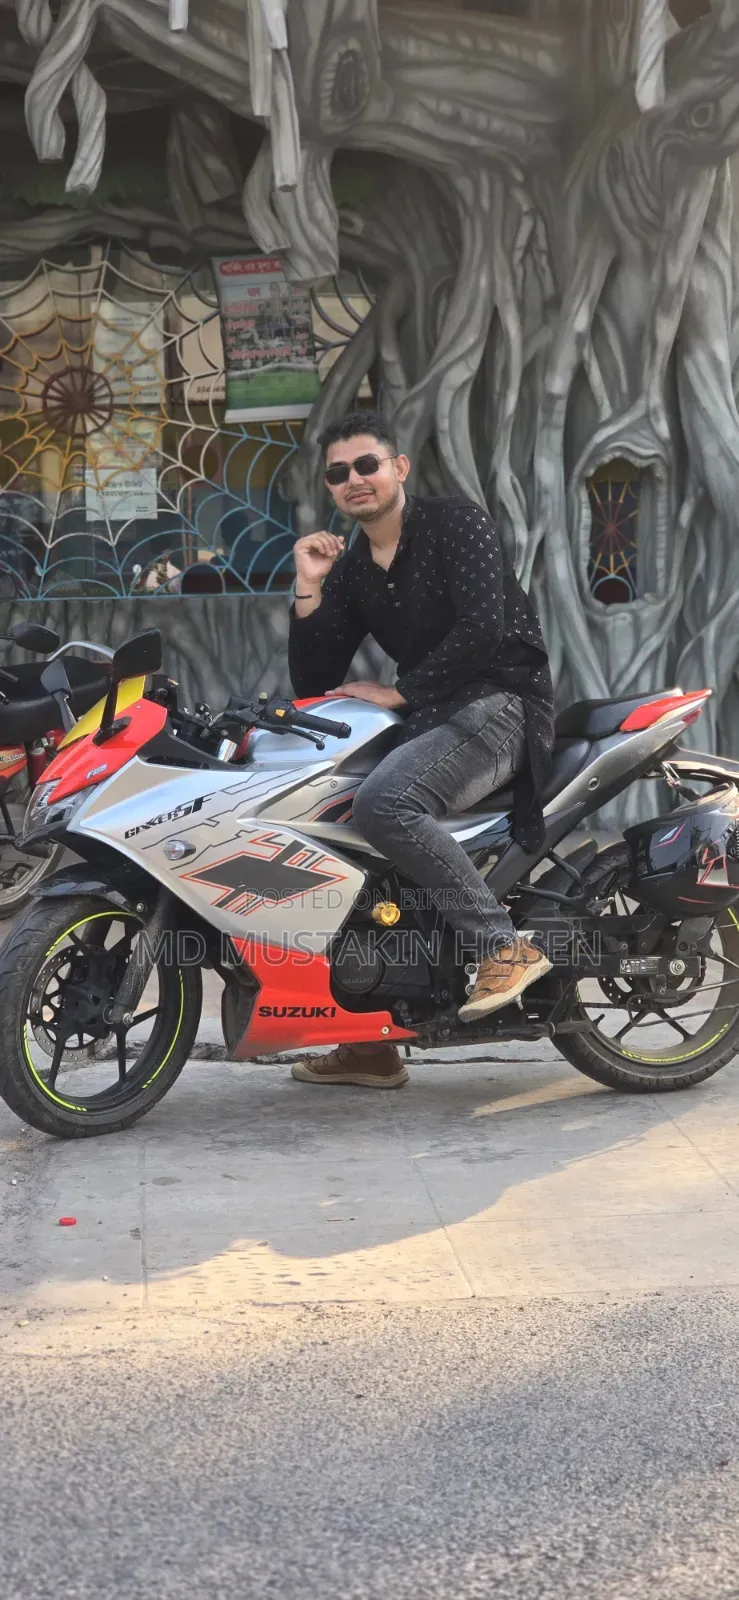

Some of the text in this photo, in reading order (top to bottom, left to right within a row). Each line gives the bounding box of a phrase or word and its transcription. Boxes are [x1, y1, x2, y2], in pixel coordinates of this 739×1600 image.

[124, 791, 216, 839] GIXXER SF
[258, 1006, 336, 1018] SUZUKI
